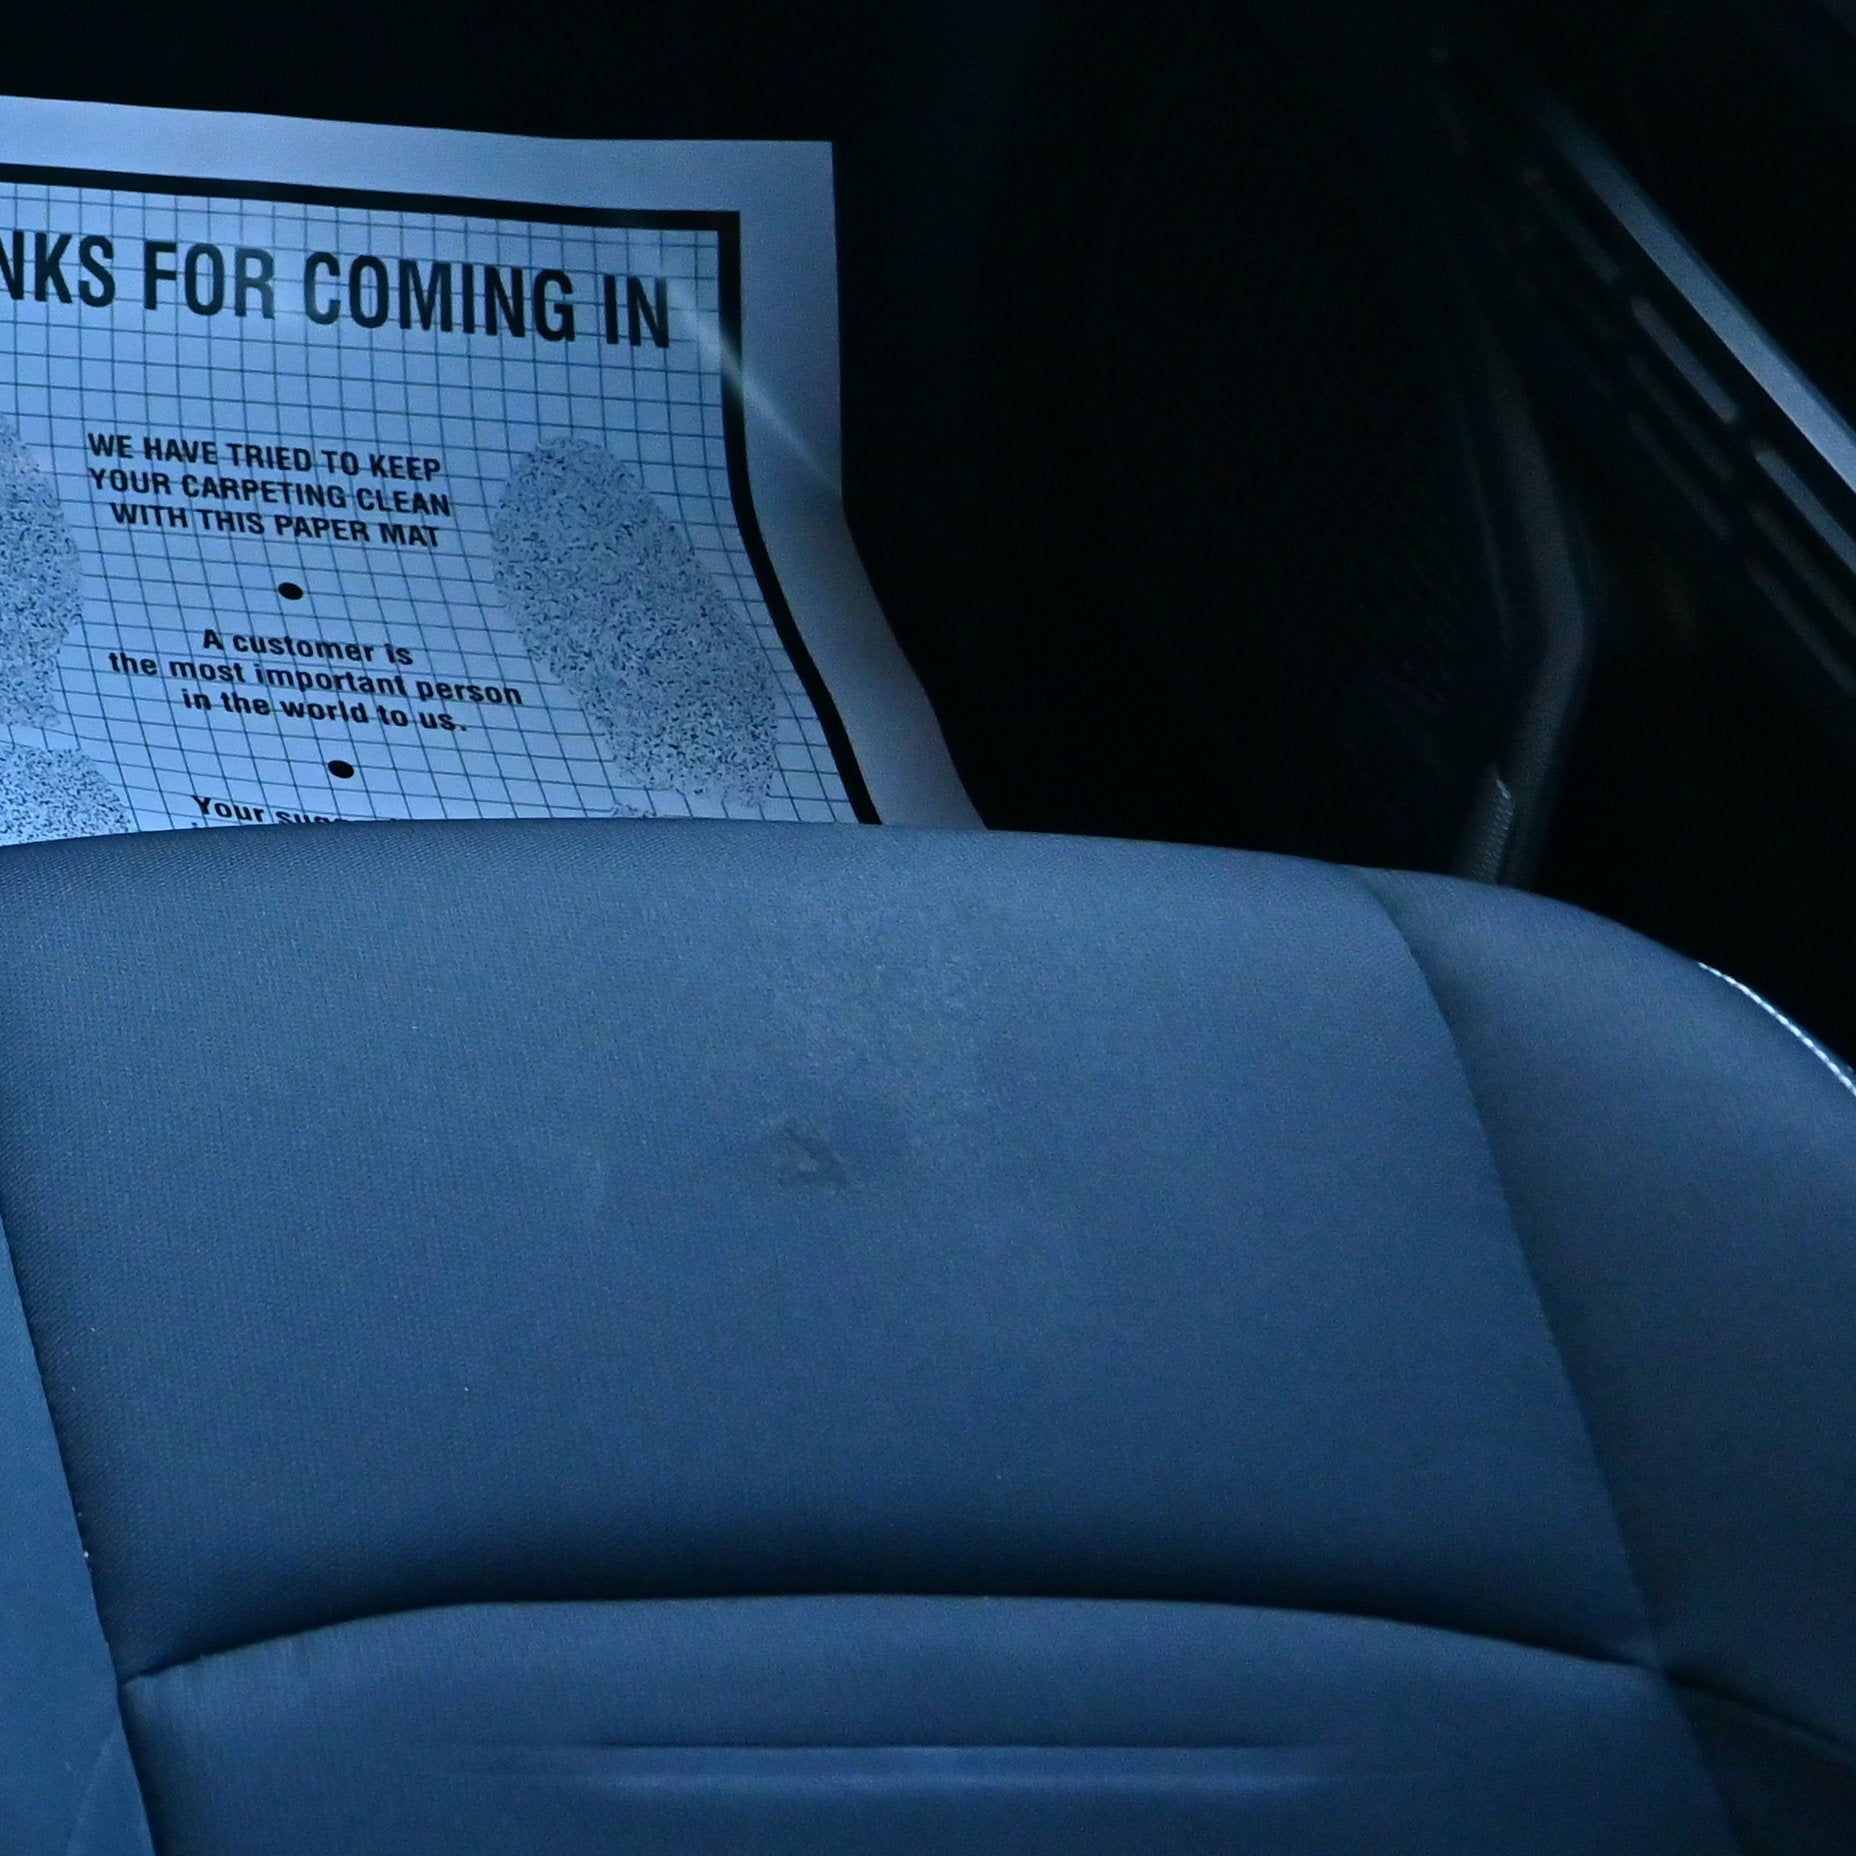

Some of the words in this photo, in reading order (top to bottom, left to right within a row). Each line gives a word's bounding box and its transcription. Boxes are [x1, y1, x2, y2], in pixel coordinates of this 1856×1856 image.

[143, 239, 275, 319] FOR
[304, 251, 575, 342] COMING
[604, 273, 670, 348] IN
[88, 432, 133, 459] WE
[144, 436, 218, 466] HAVE
[226, 442, 312, 472] TRIED
[321, 449, 359, 476] TO
[370, 453, 441, 482] KEEP
[90, 468, 172, 495] YOUR
[182, 474, 346, 509] CARPETING
[357, 487, 451, 517] CLEAN
[109, 502, 188, 529] WITH
[196, 508, 265, 535] THIS
[274, 515, 371, 543] PAPER
[379, 522, 440, 547] MAT
[203, 629, 223, 650] A
[233, 634, 374, 663] customer
[387, 643, 414, 666] is
[109, 652, 157, 676] the
[170, 661, 246, 684] most
[255, 663, 408, 697] important
[416, 679, 523, 706] person
[182, 688, 211, 711] in
[221, 691, 271, 716] the
[281, 699, 369, 725] world
[377, 706, 408, 729] to
[420, 711, 467, 732] us.
[192, 795, 265, 824] Your
